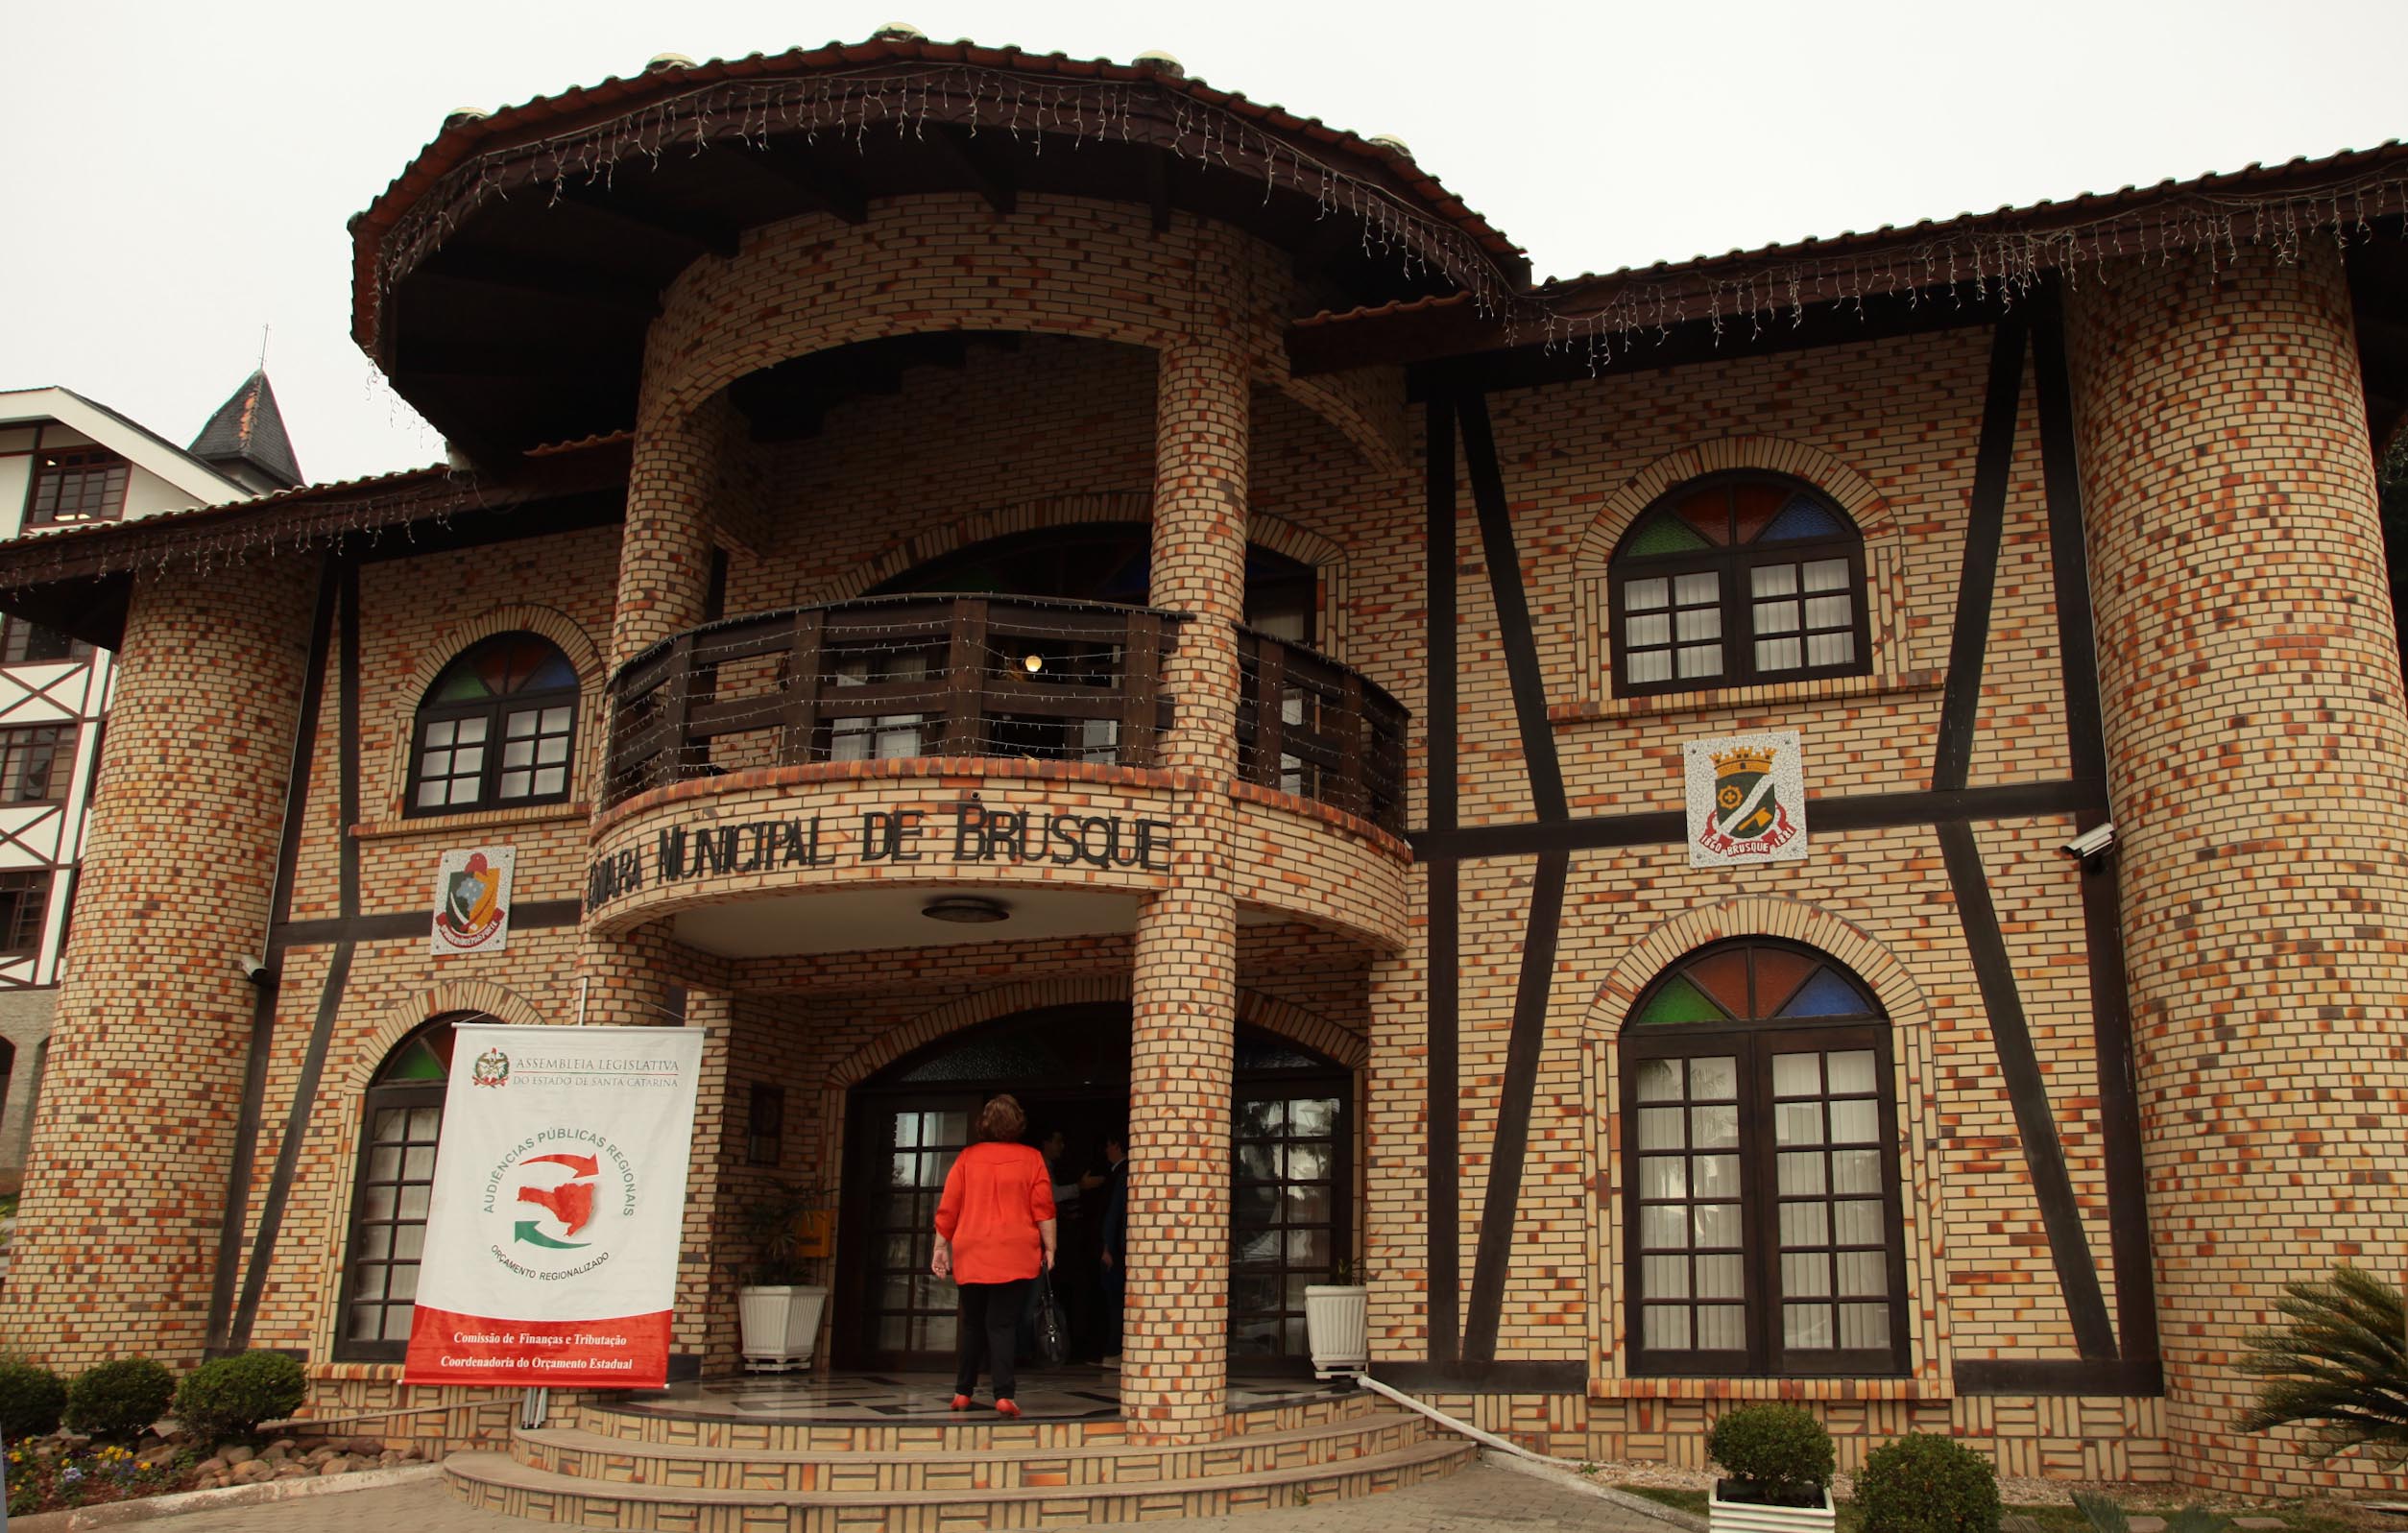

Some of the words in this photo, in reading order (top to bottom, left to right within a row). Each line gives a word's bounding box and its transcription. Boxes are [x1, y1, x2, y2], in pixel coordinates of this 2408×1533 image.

[657, 816, 835, 885] MUNICIPAL
[861, 810, 925, 861] DE
[953, 803, 1171, 871] BRUSQUE
[1700, 834, 1722, 852] 1860
[1726, 843, 1770, 856] BRUSQUE
[1773, 826, 1794, 847] 1881
[516, 1058, 594, 1069] ASSEMBLEIA
[599, 1059, 679, 1071] LEGISLATIVA
[513, 1076, 530, 1086] DO
[532, 1076, 571, 1086] ESTADO
[576, 1077, 589, 1087] DE
[591, 1077, 624, 1087] SANTA
[627, 1078, 678, 1088] CATARINA
[483, 1138, 535, 1213] AUDIÊNCIAS
[538, 1126, 607, 1148] PÚBLICAS
[606, 1143, 637, 1217] REGIONAIS
[491, 1244, 537, 1279] ORÇAMENTO
[539, 1252, 609, 1281] REGIONALIZADO
[453, 1330, 500, 1344] Comissão
[502, 1332, 515, 1344] de
[518, 1332, 564, 1346] Finanças
[574, 1333, 627, 1347] Tributação
[441, 1354, 515, 1368] Coordenadoria
[517, 1356, 529, 1368] do
[532, 1356, 587, 1370] Orçamento
[590, 1357, 633, 1370] Estadual
